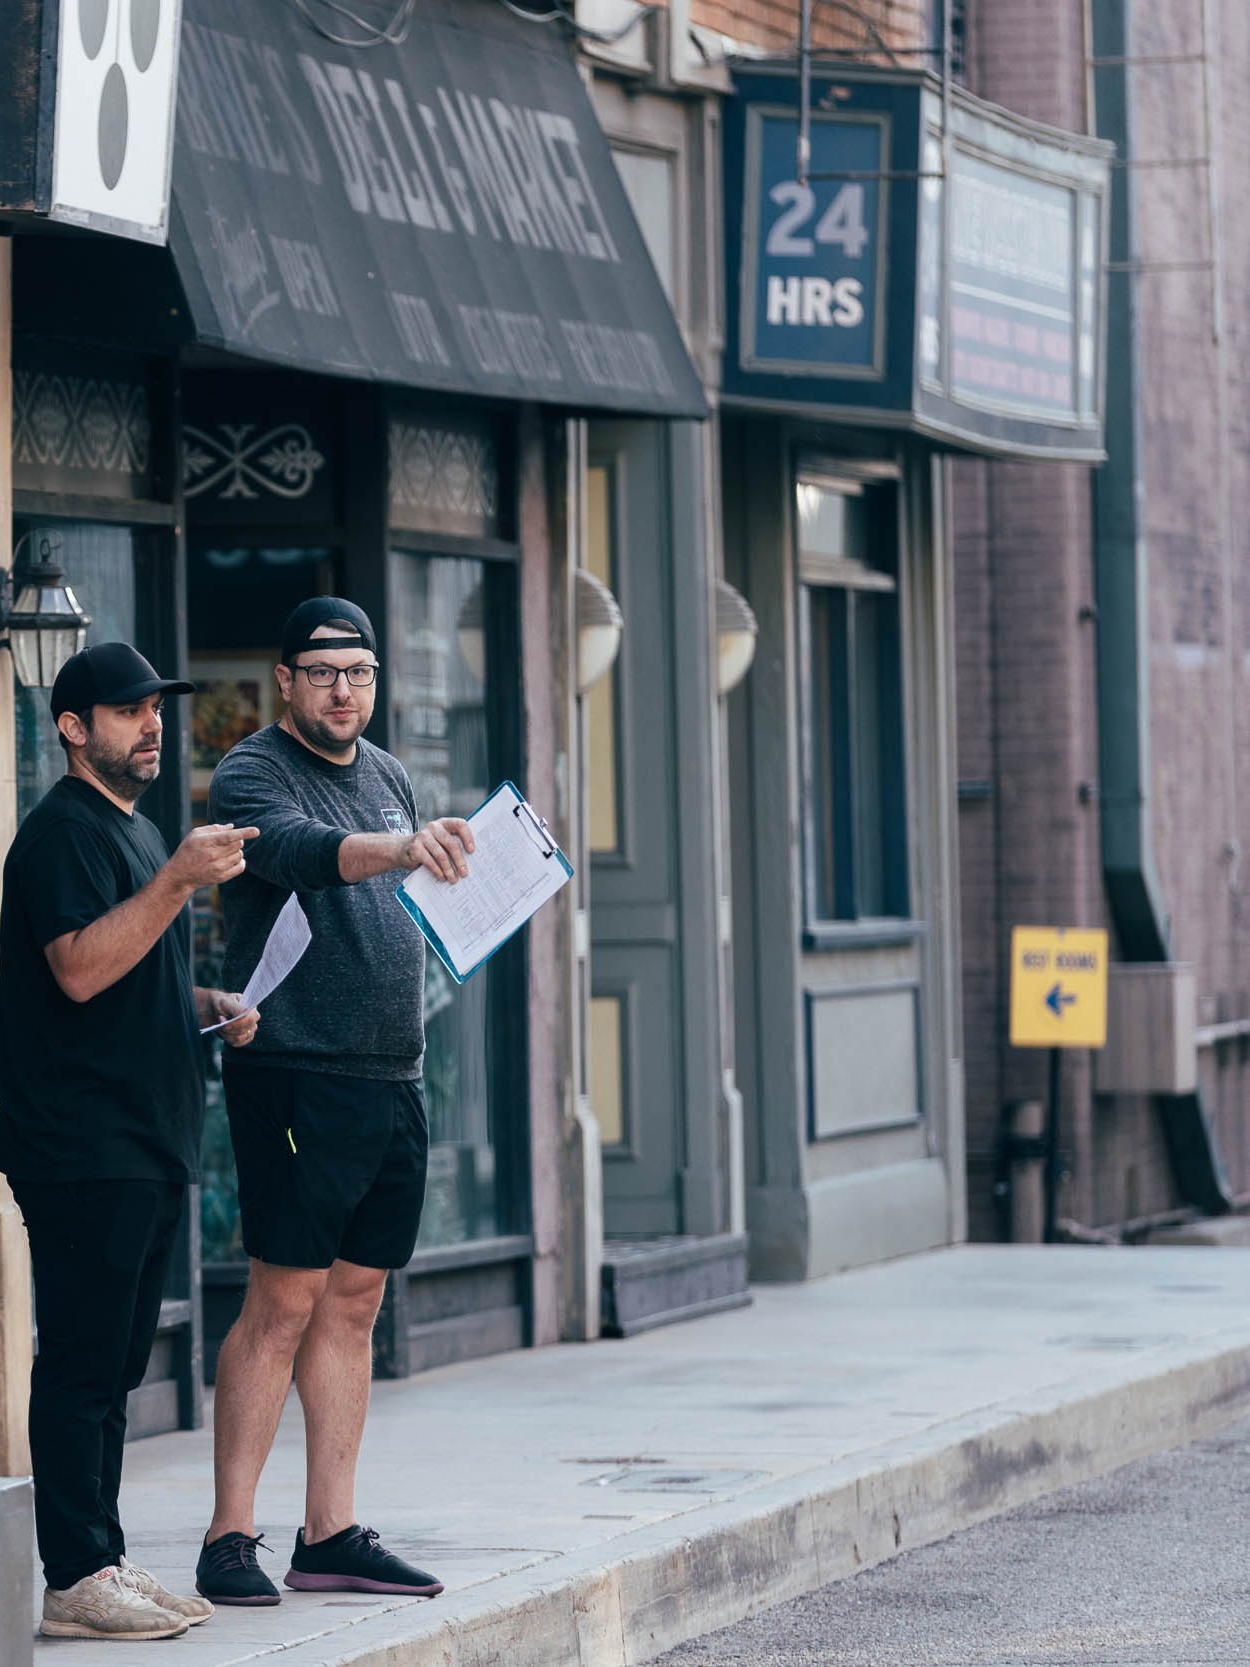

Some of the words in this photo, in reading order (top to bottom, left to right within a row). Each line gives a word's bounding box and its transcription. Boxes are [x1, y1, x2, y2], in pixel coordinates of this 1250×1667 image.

[297, 52, 454, 233] DELI
[436, 85, 622, 264] MARKET
[766, 180, 869, 259] 24
[766, 275, 865, 328] HRS
